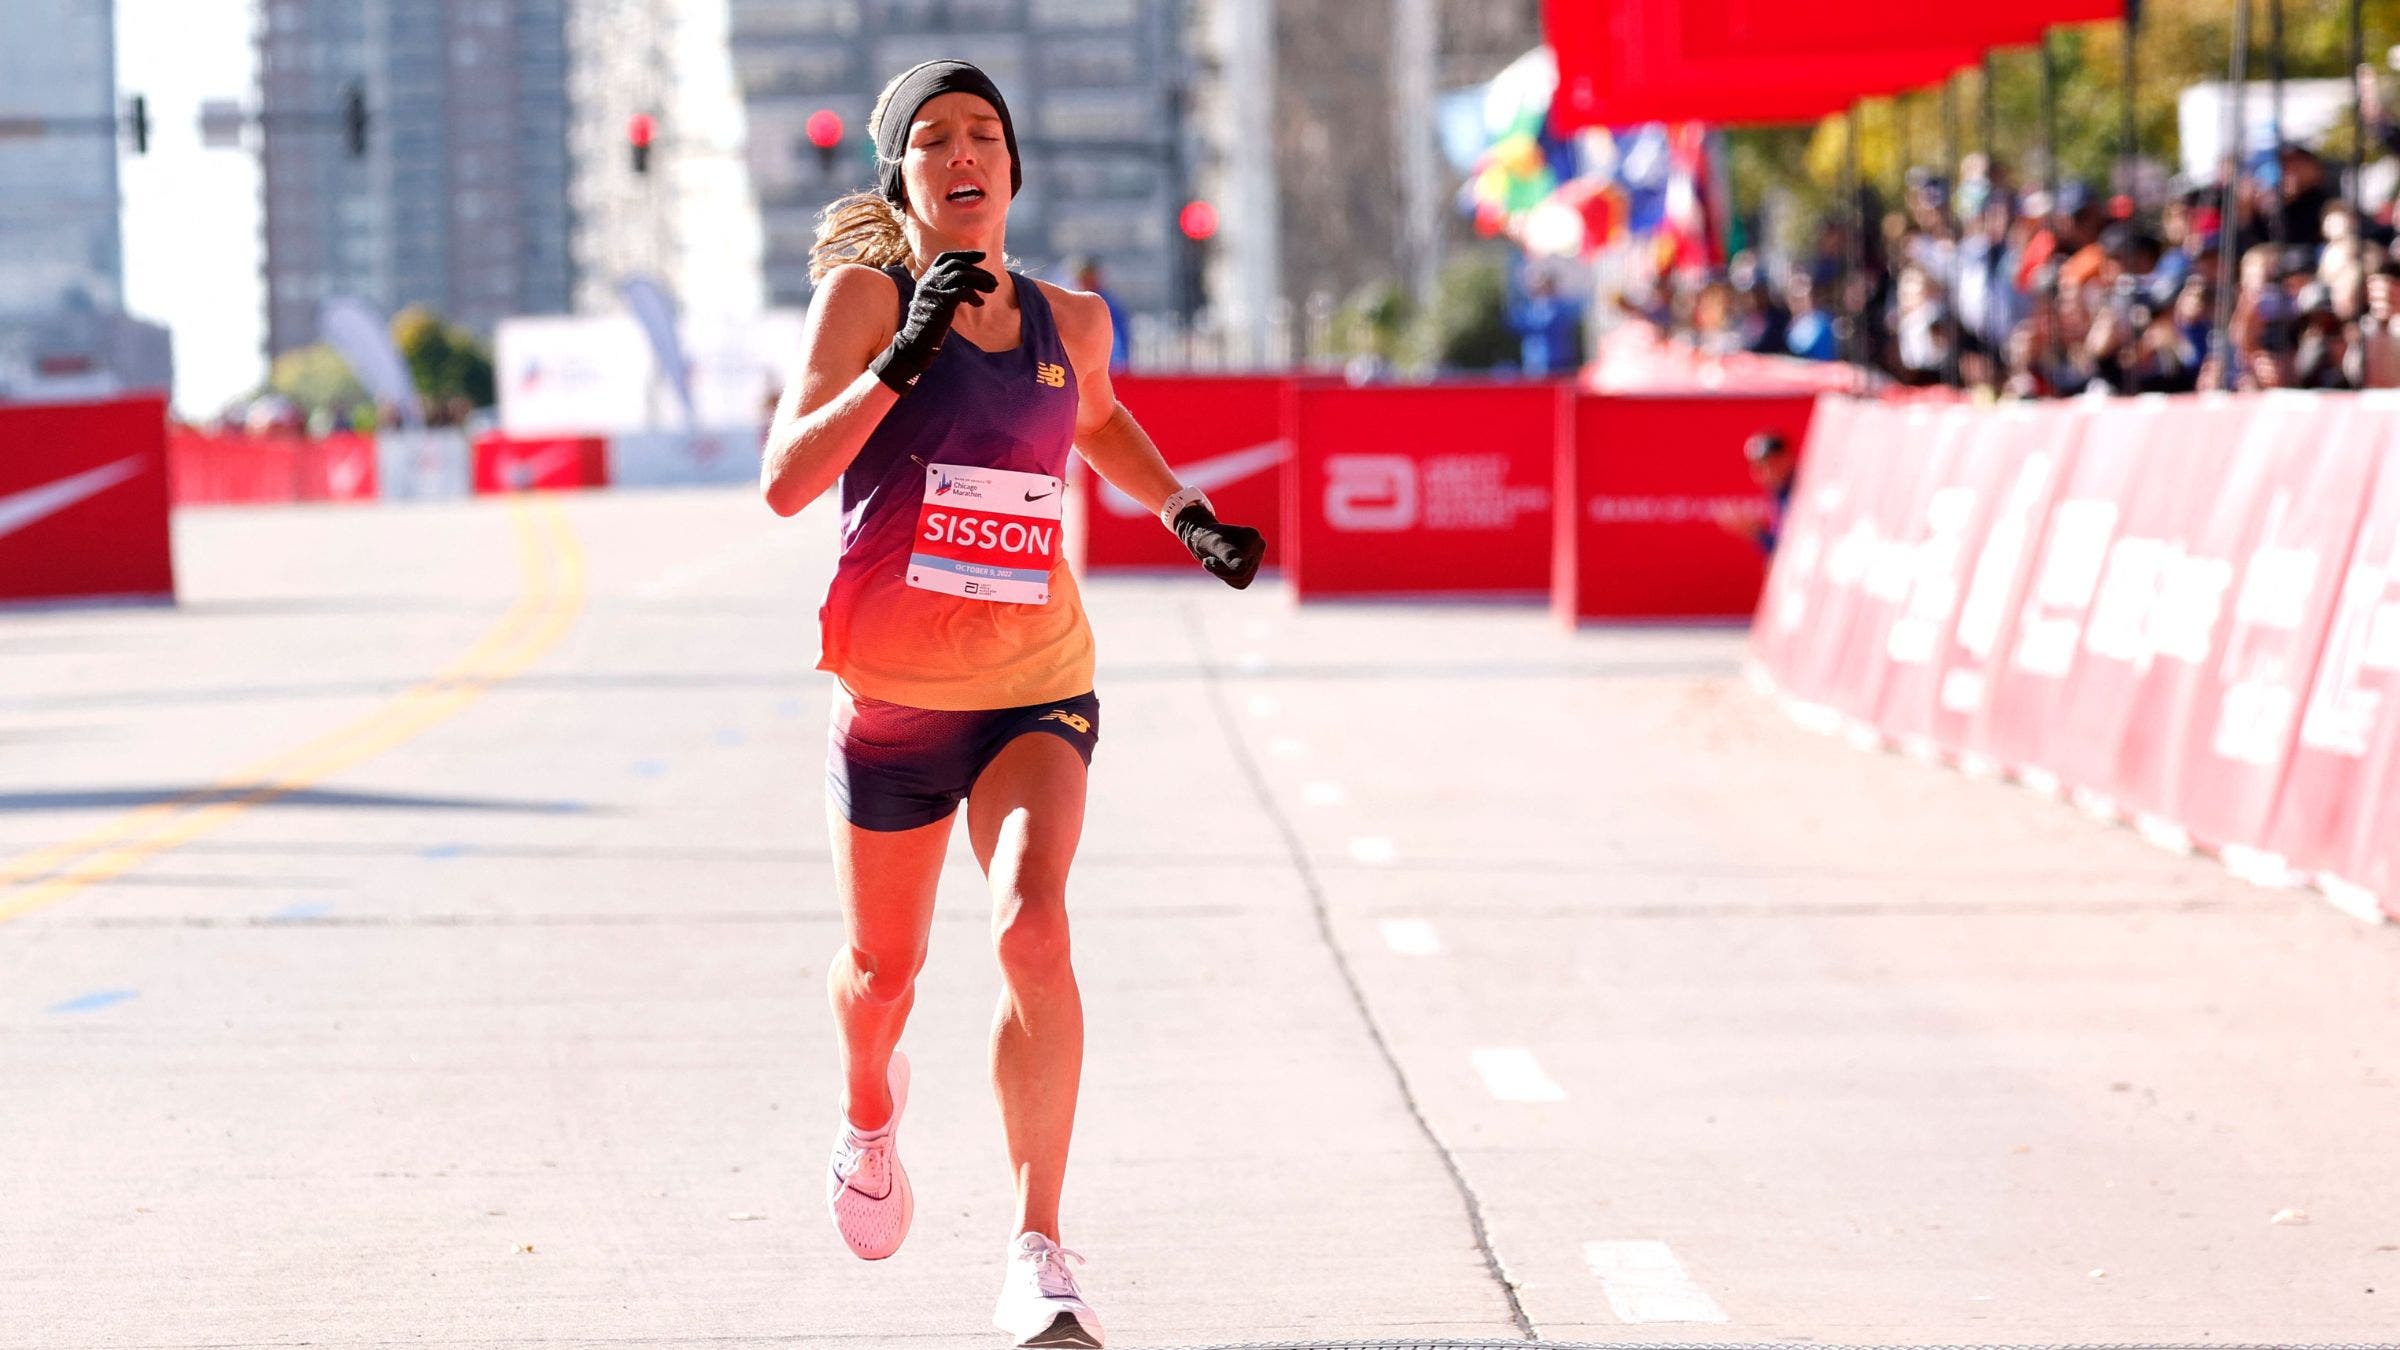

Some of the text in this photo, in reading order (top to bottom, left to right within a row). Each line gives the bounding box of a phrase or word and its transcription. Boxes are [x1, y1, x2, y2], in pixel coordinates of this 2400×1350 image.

[954, 482, 978, 491] Chicago
[953, 489, 982, 498] Marathon
[923, 513, 1053, 555] SISSON
[955, 563, 989, 575] OCTOBER
